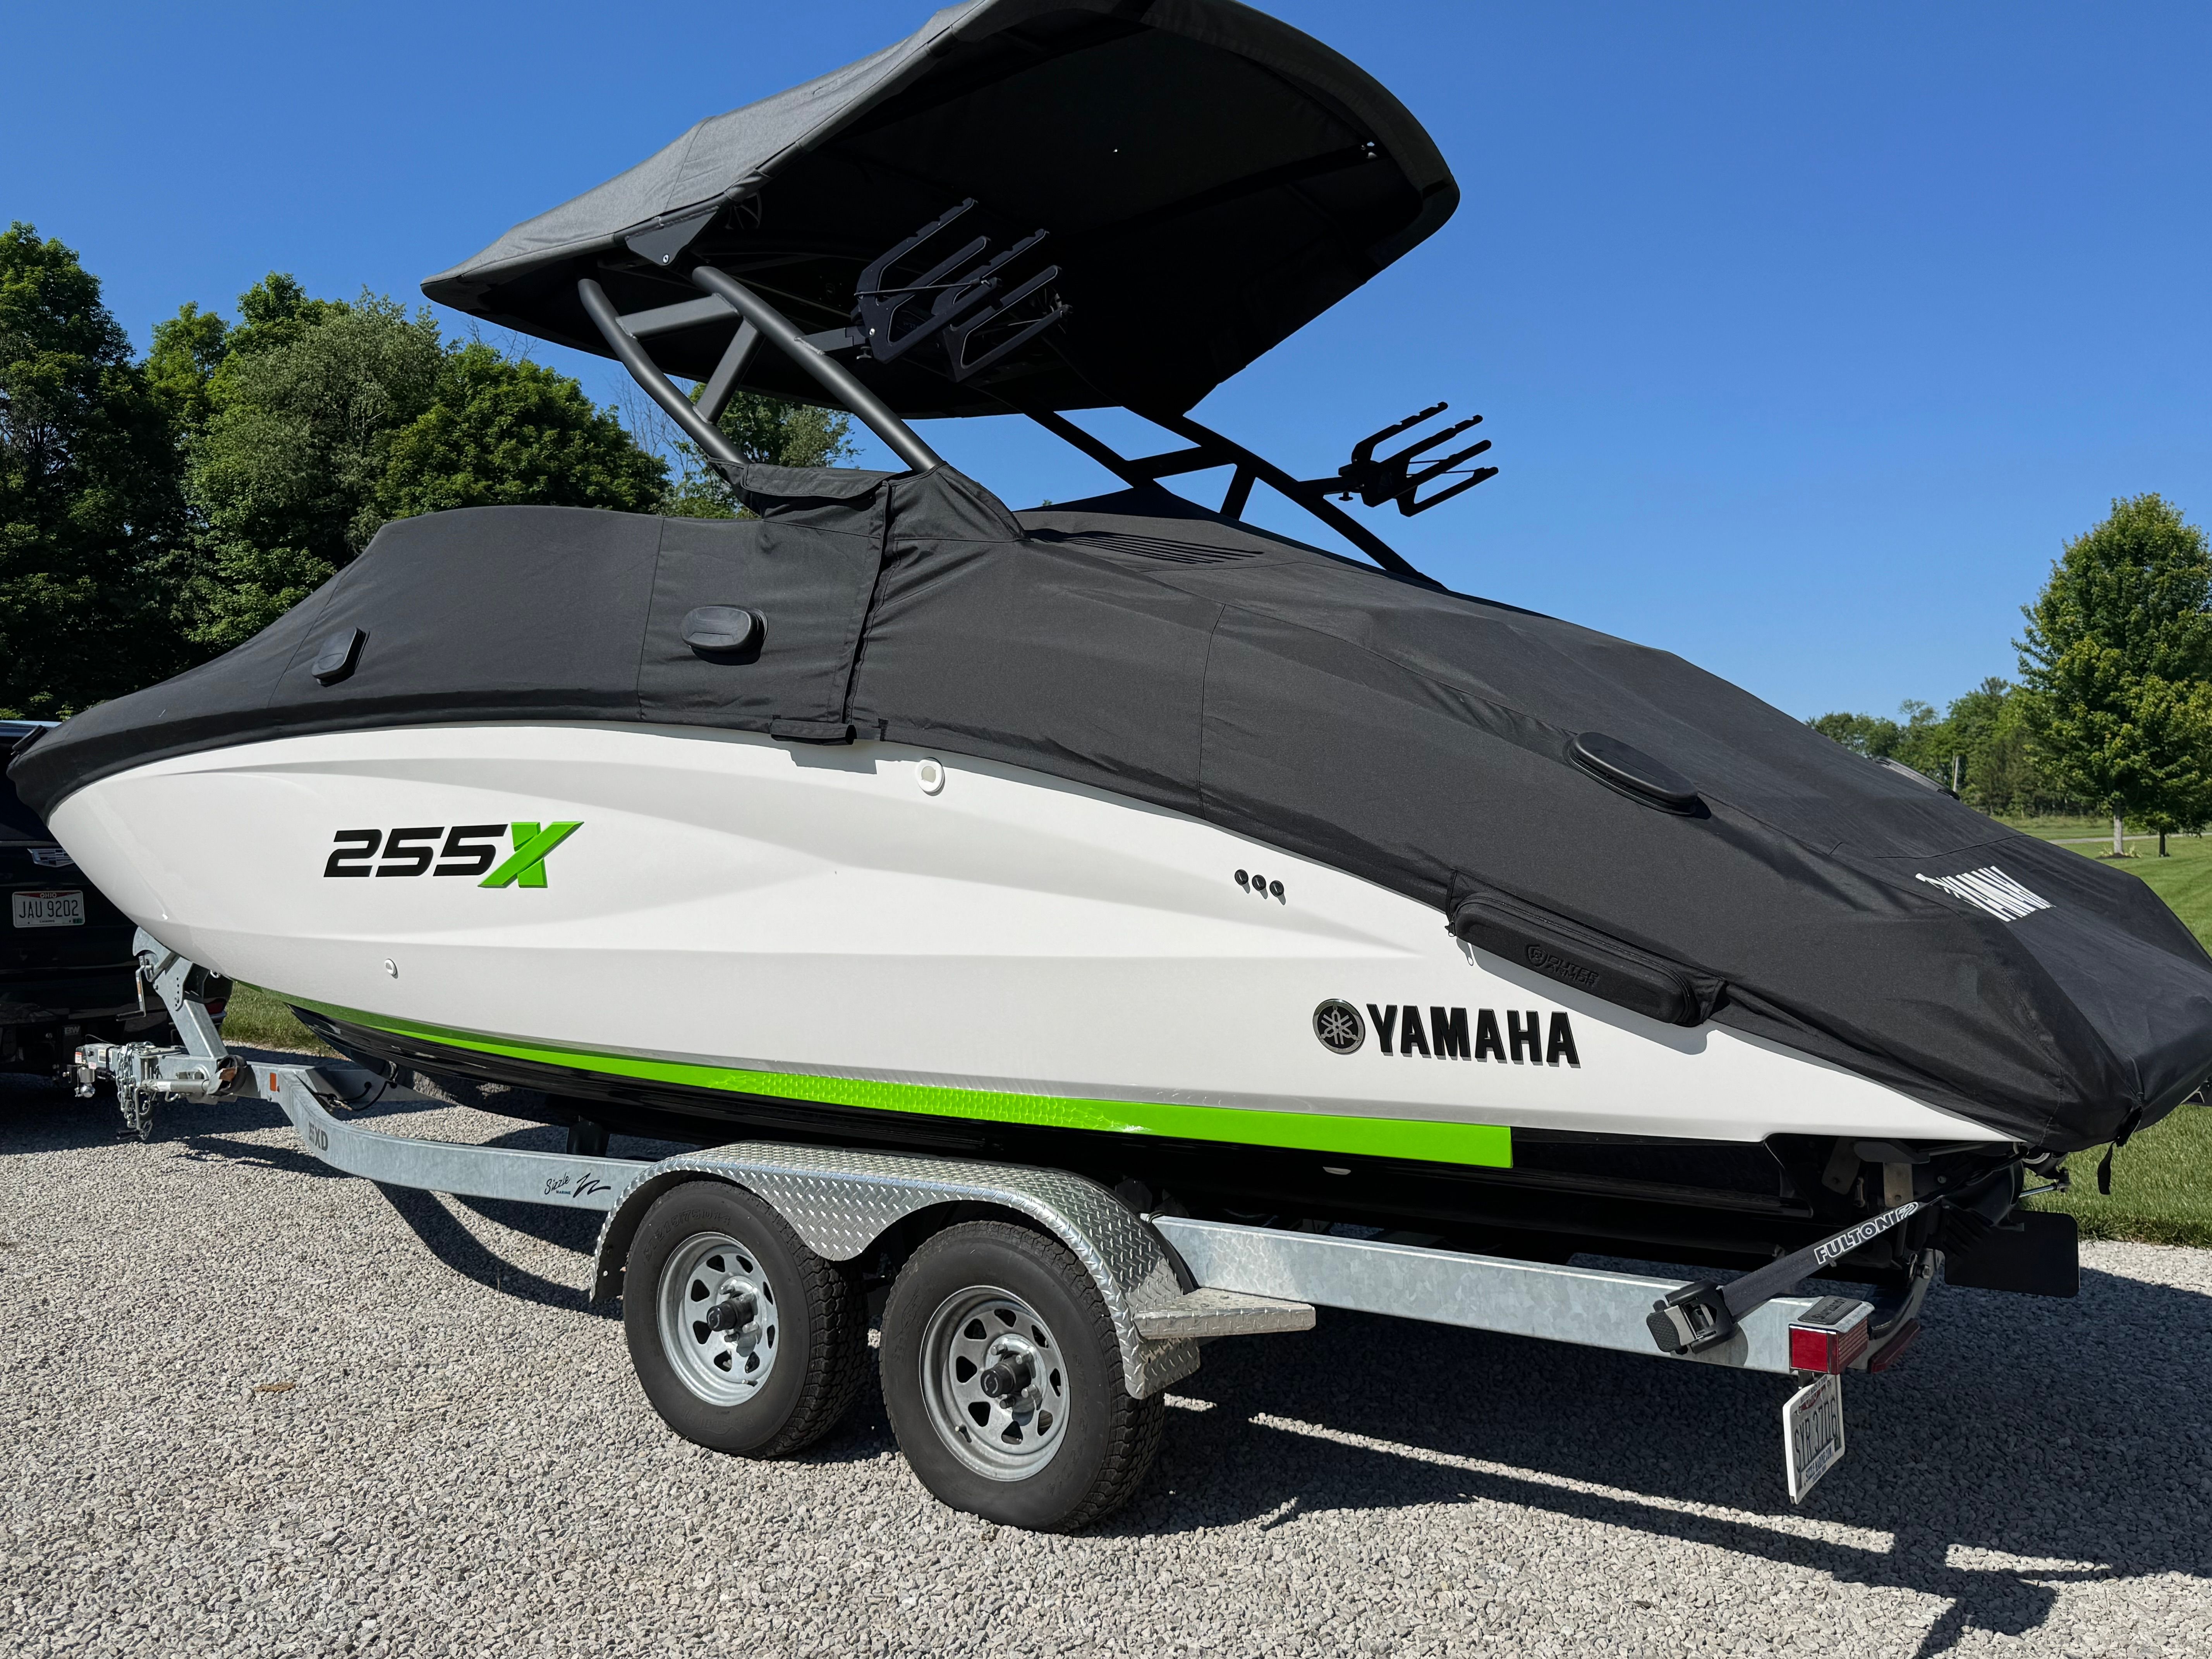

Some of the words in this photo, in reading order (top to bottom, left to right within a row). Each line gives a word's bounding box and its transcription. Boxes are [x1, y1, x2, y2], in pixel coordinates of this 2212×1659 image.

[324, 821, 584, 888] 255X
[19, 901, 43, 918] JAU
[47, 900, 79, 917] 9202
[1366, 1003, 1580, 1066] YAMAHA
[544, 1172, 570, 1195] Sizzle
[1814, 1211, 1895, 1265] FULTON
[1794, 1417, 1812, 1473] SYR
[1813, 1397, 1838, 1453] 3706
